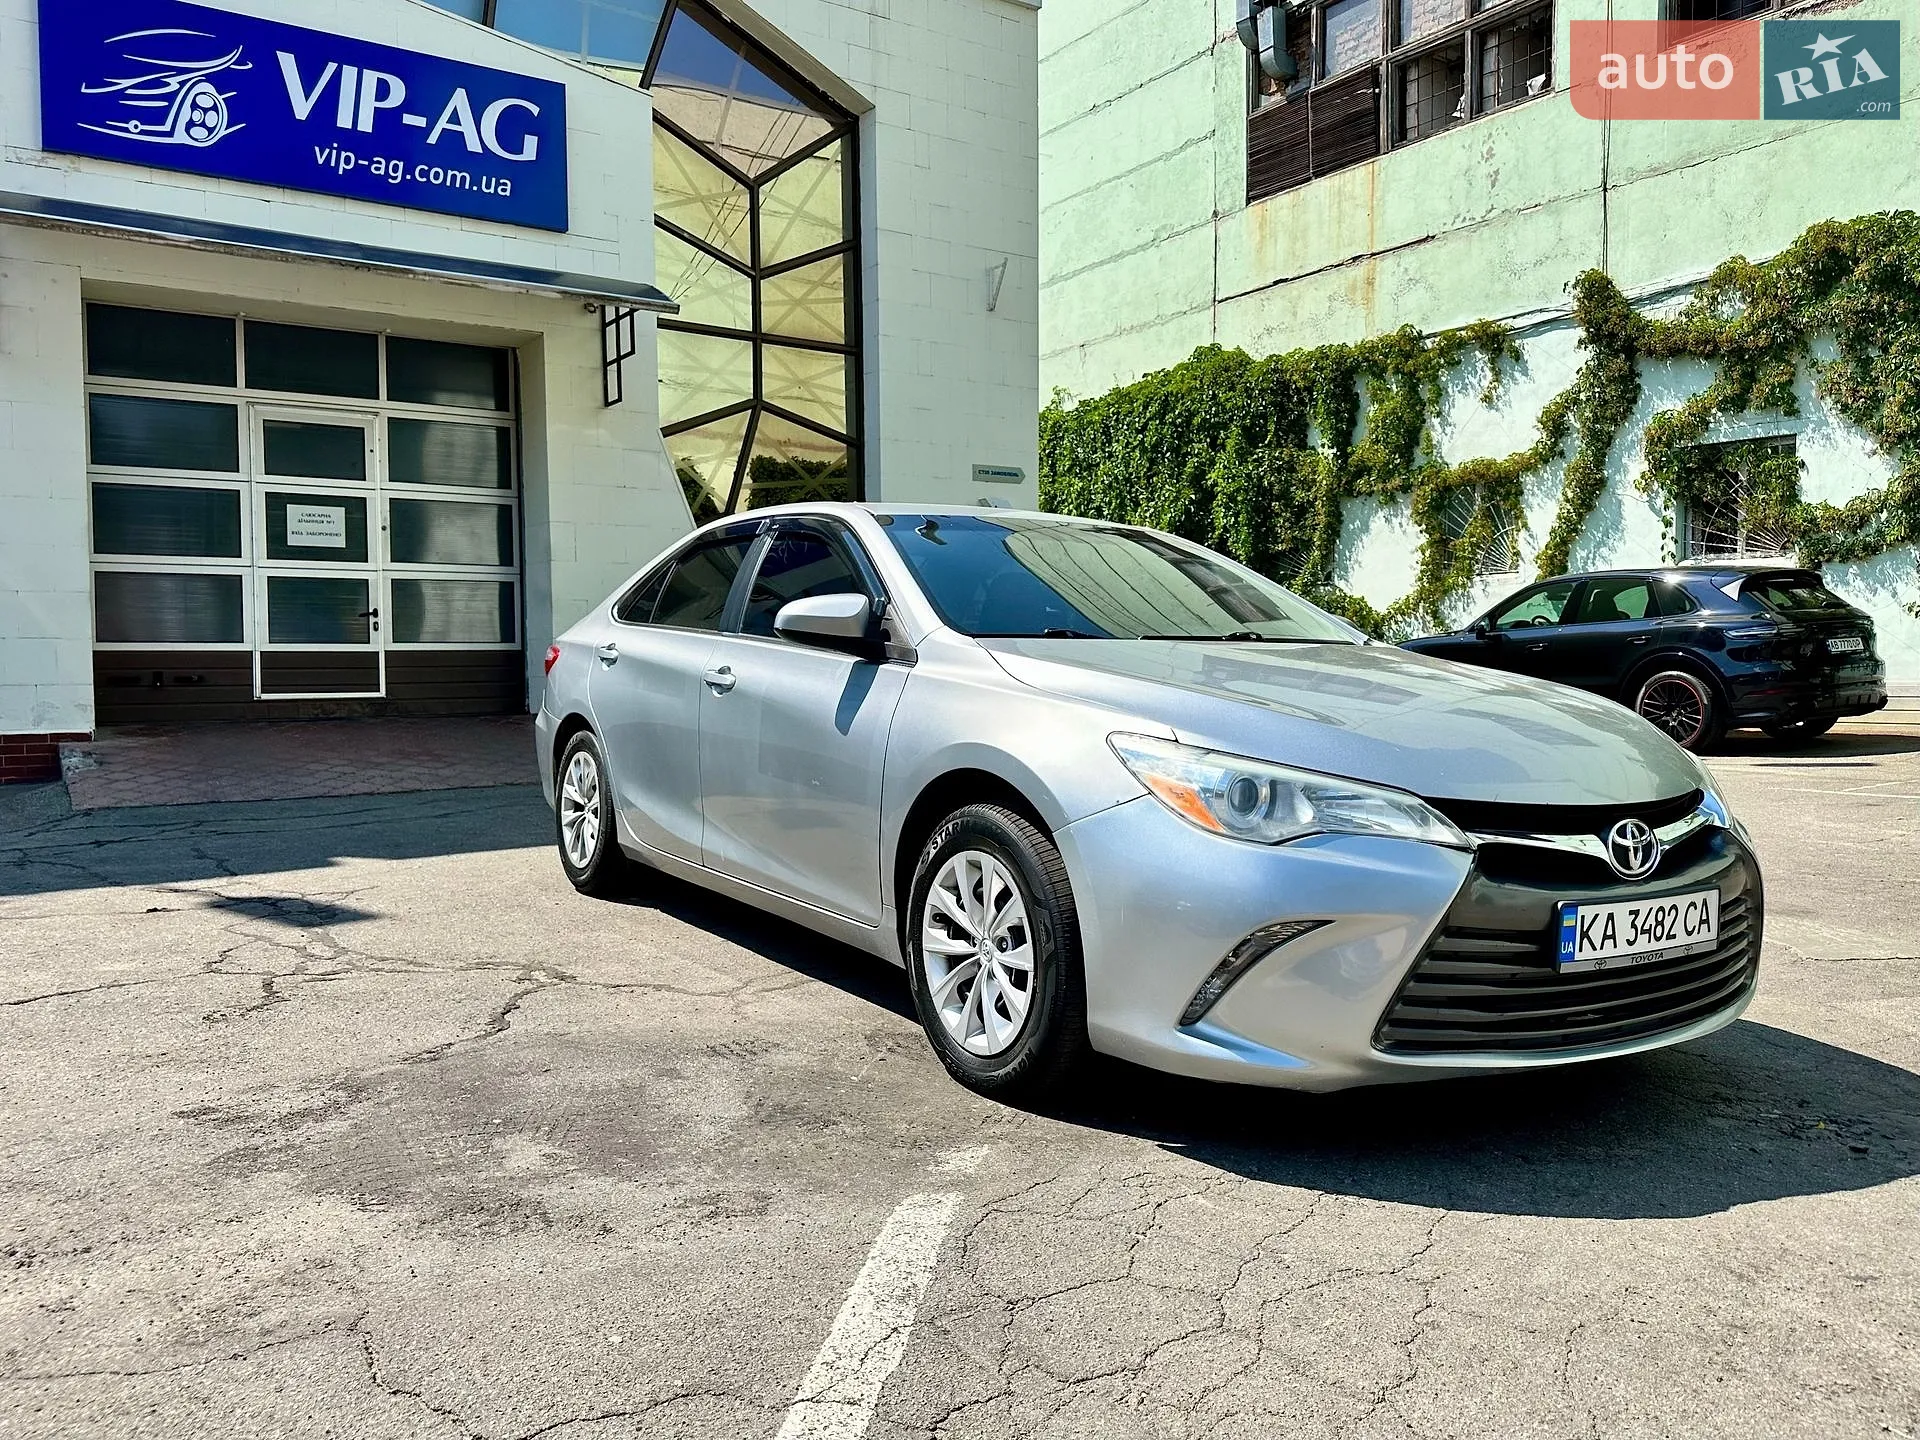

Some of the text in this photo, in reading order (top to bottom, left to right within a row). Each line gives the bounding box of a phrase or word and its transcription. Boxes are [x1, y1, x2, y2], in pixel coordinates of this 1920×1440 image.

[276, 50, 541, 162] VIP-AG
[314, 142, 512, 197] vip-ag.com.ua
[1561, 941, 1574, 954] UA
[1579, 898, 1711, 953] KA 3482 CA
[1630, 951, 1665, 964] TOYOTA
